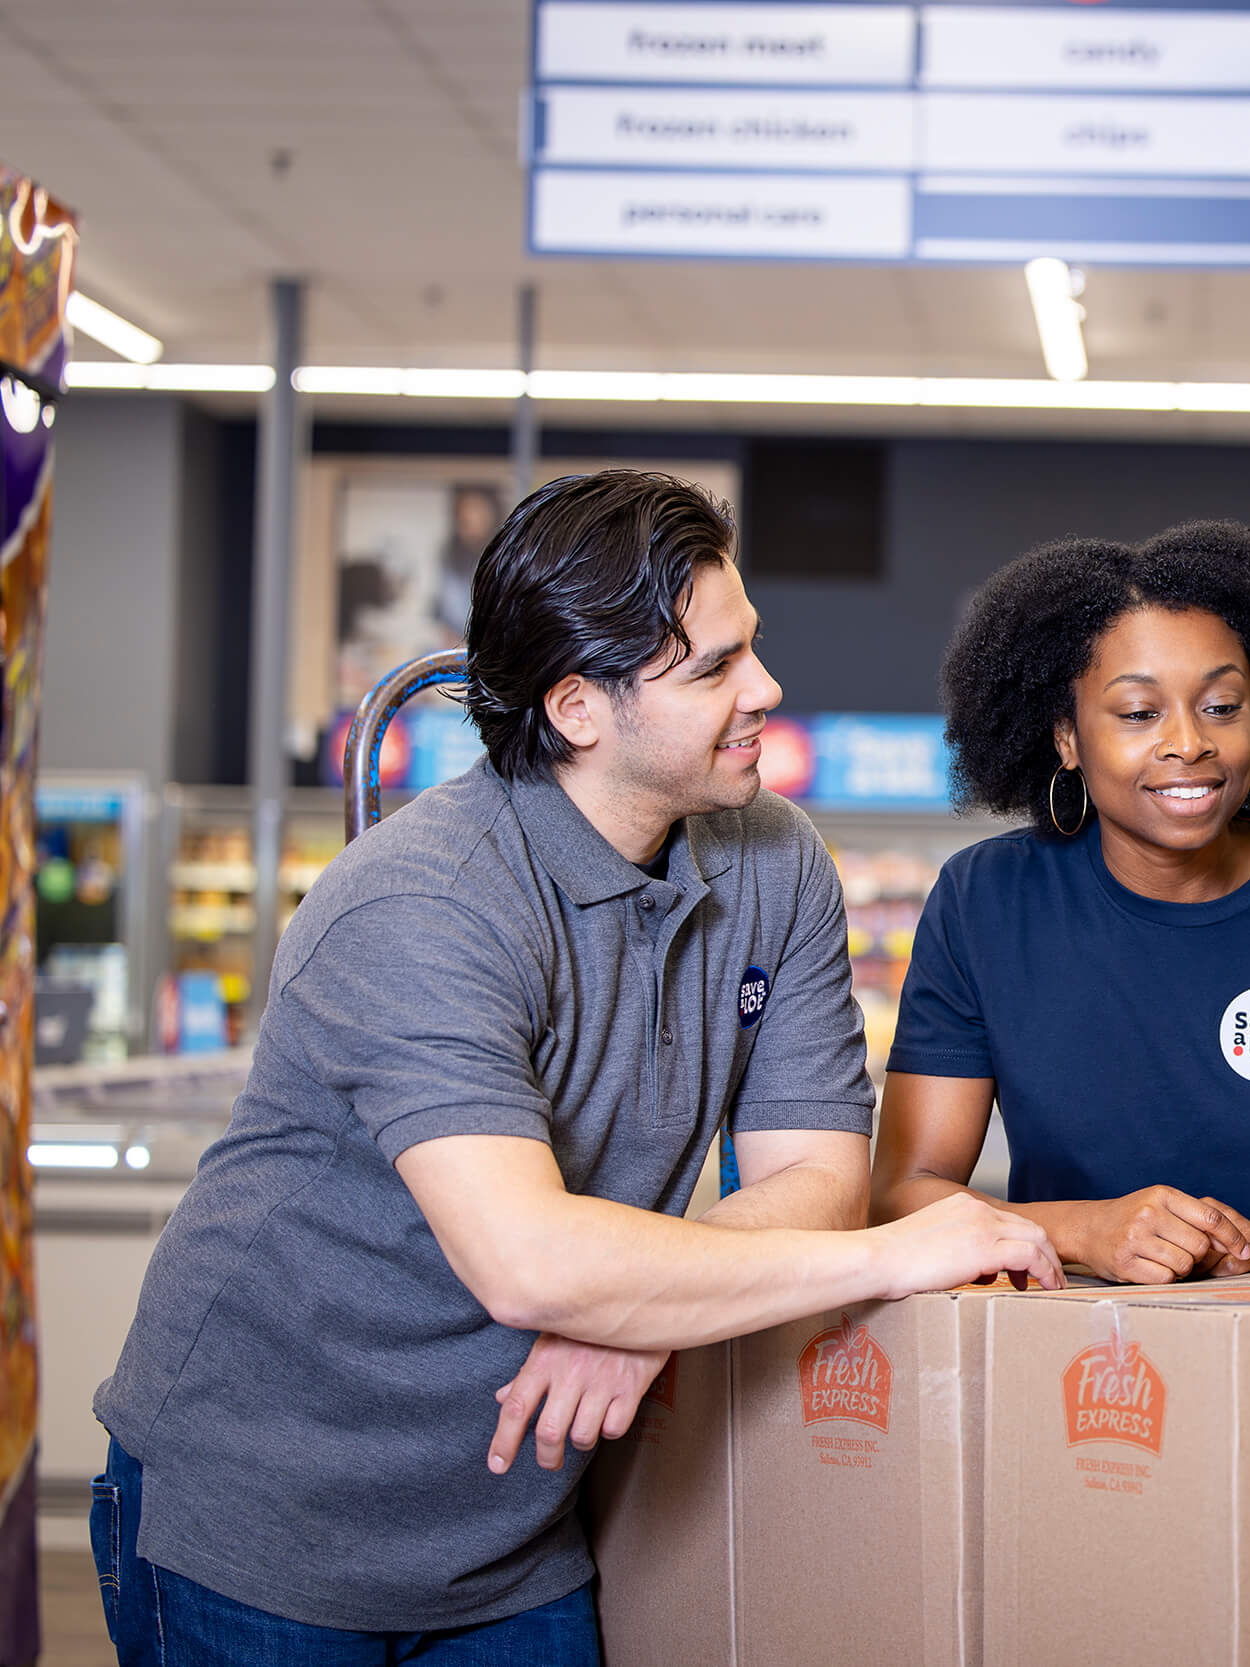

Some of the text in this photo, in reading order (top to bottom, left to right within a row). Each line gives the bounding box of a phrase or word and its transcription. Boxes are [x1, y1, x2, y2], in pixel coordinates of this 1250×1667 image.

[628, 31, 824, 55] frozen meat
[617, 112, 851, 141] frozen chicken
[622, 202, 752, 228] personal
[741, 980, 765, 997] save
[1233, 1032, 1246, 1046] a
[812, 1338, 881, 1391] Fresh
[1078, 1356, 1153, 1411] Fresh
[811, 1389, 880, 1416] EXPRESS
[1076, 1408, 1153, 1439] EXPRESS
